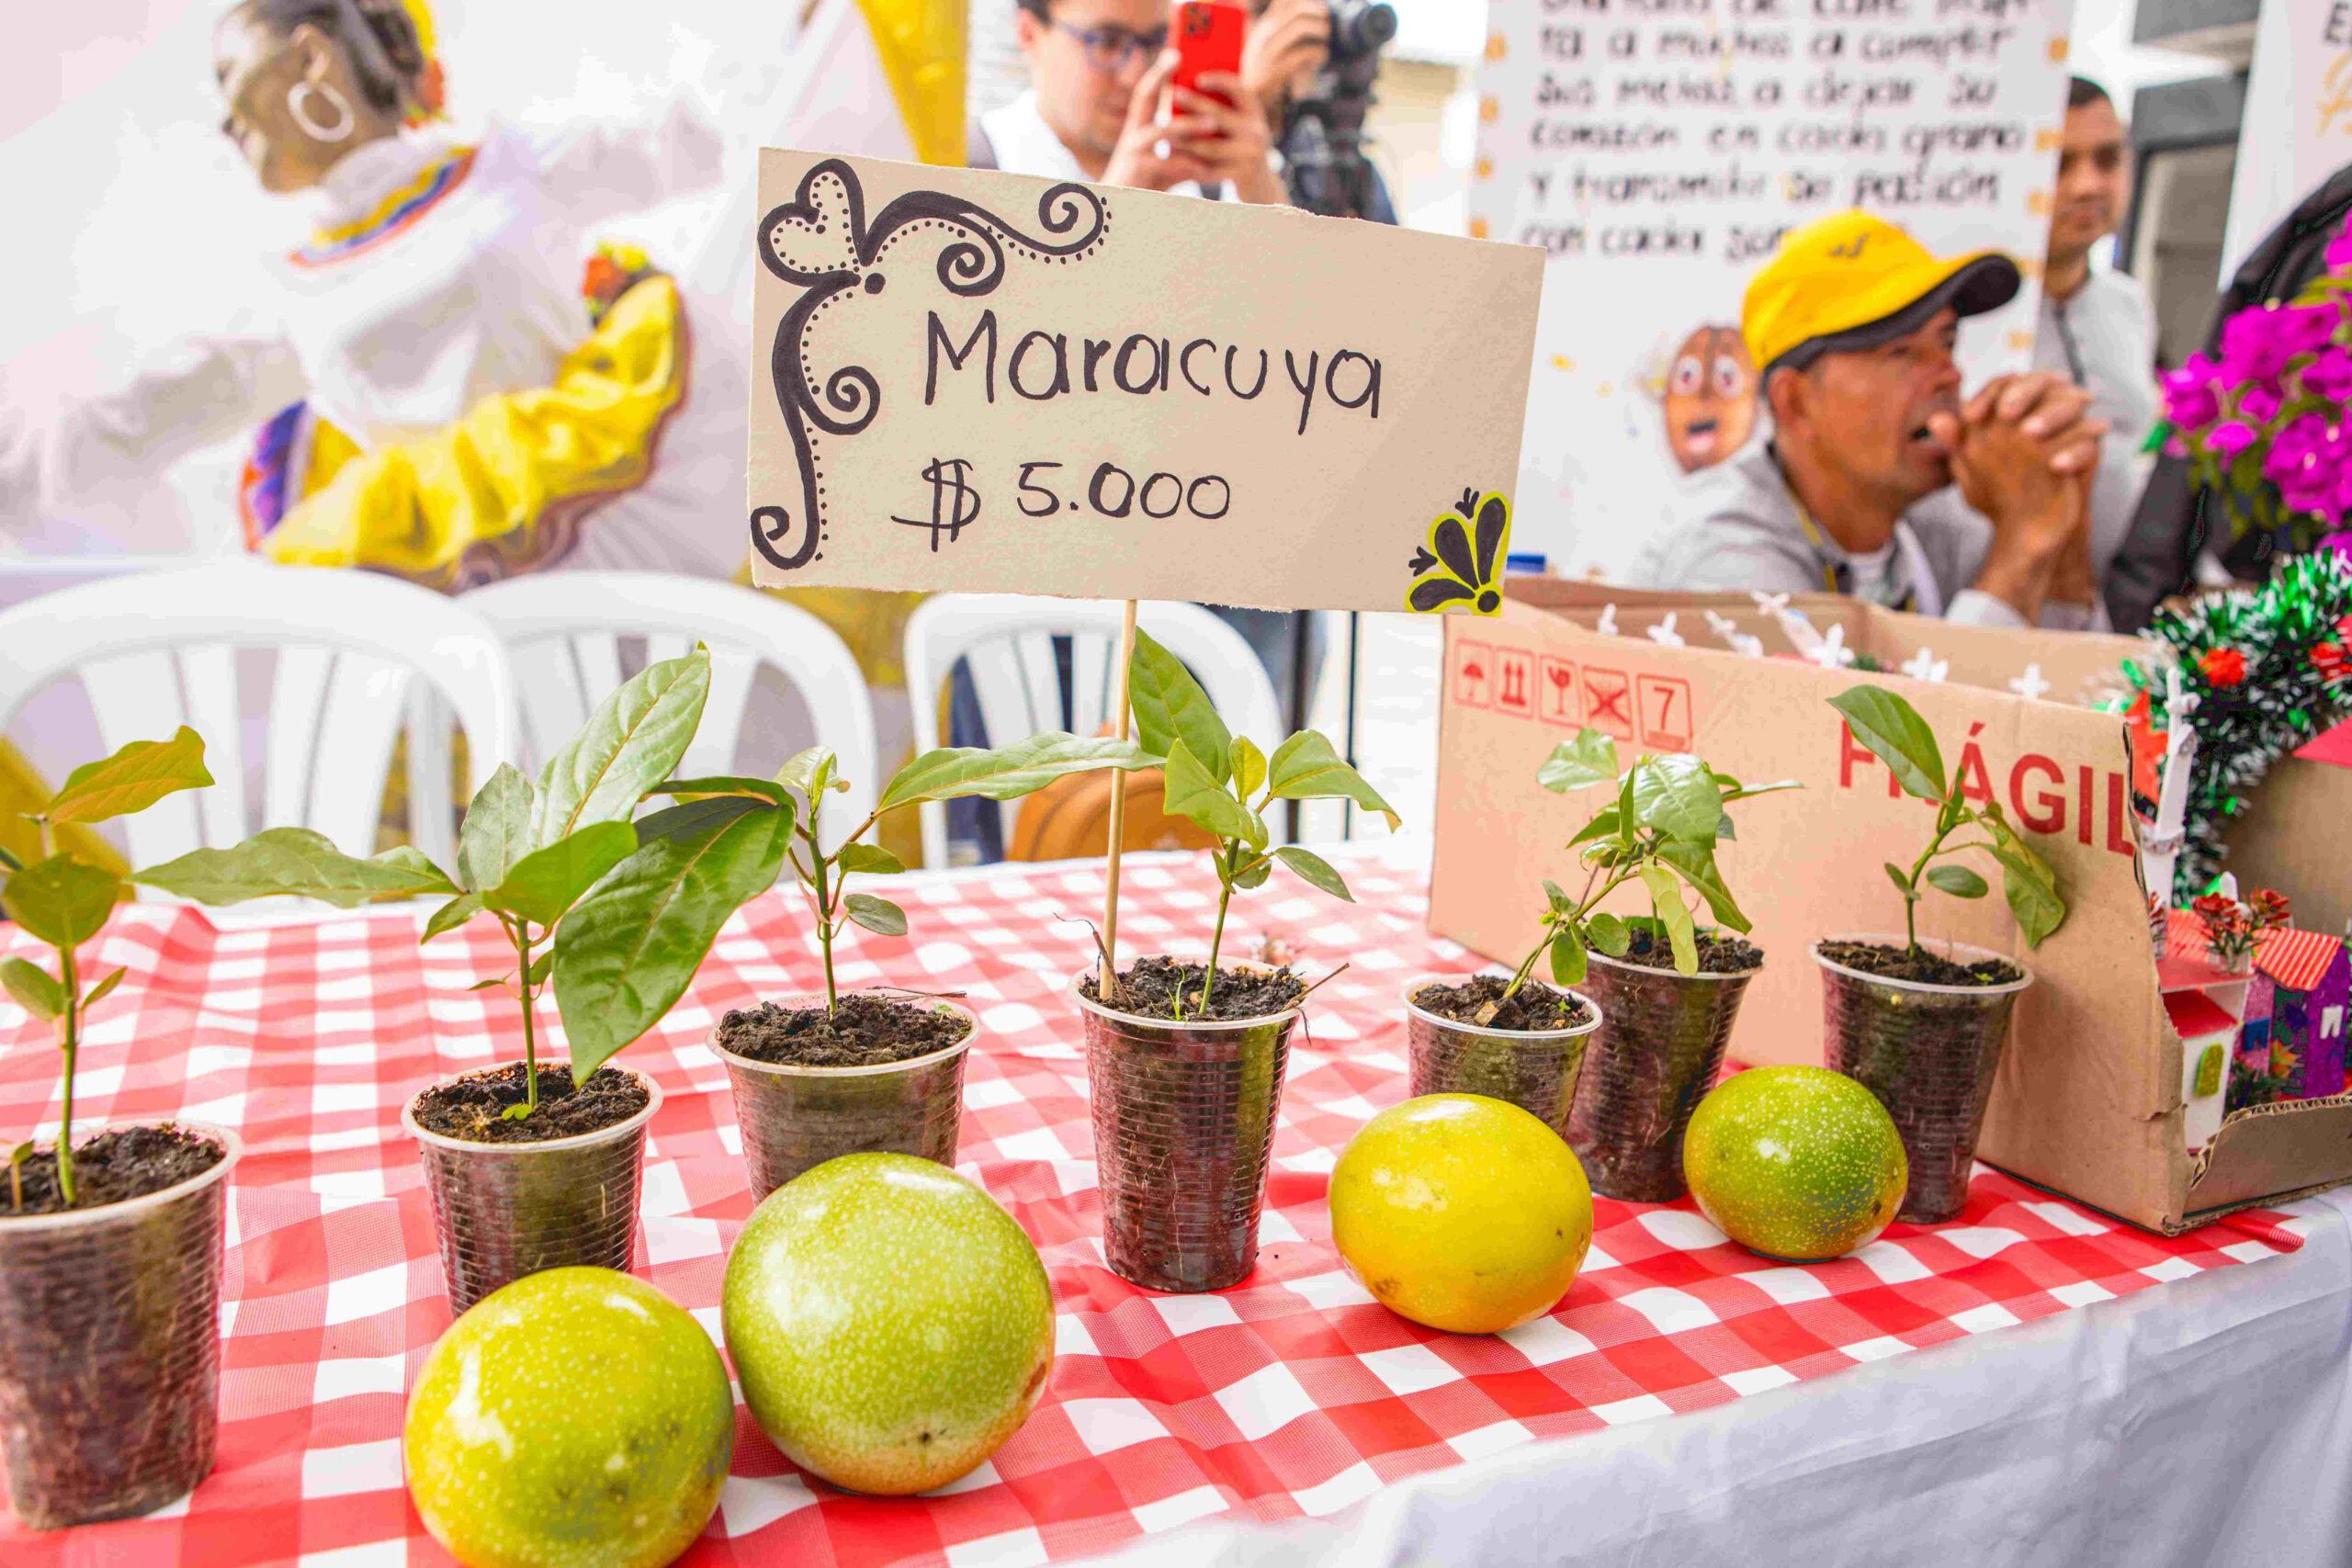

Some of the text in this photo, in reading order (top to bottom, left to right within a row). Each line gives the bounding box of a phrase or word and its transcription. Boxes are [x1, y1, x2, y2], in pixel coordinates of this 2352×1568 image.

[1608, 29, 1634, 57] a
[1810, 31, 1844, 57] a
[925, 310, 1381, 434] Maracuya
[891, 457, 1230, 552] $ 5.000
[1653, 686, 1676, 730] 7
[1840, 719, 2135, 857] FÁGIL
